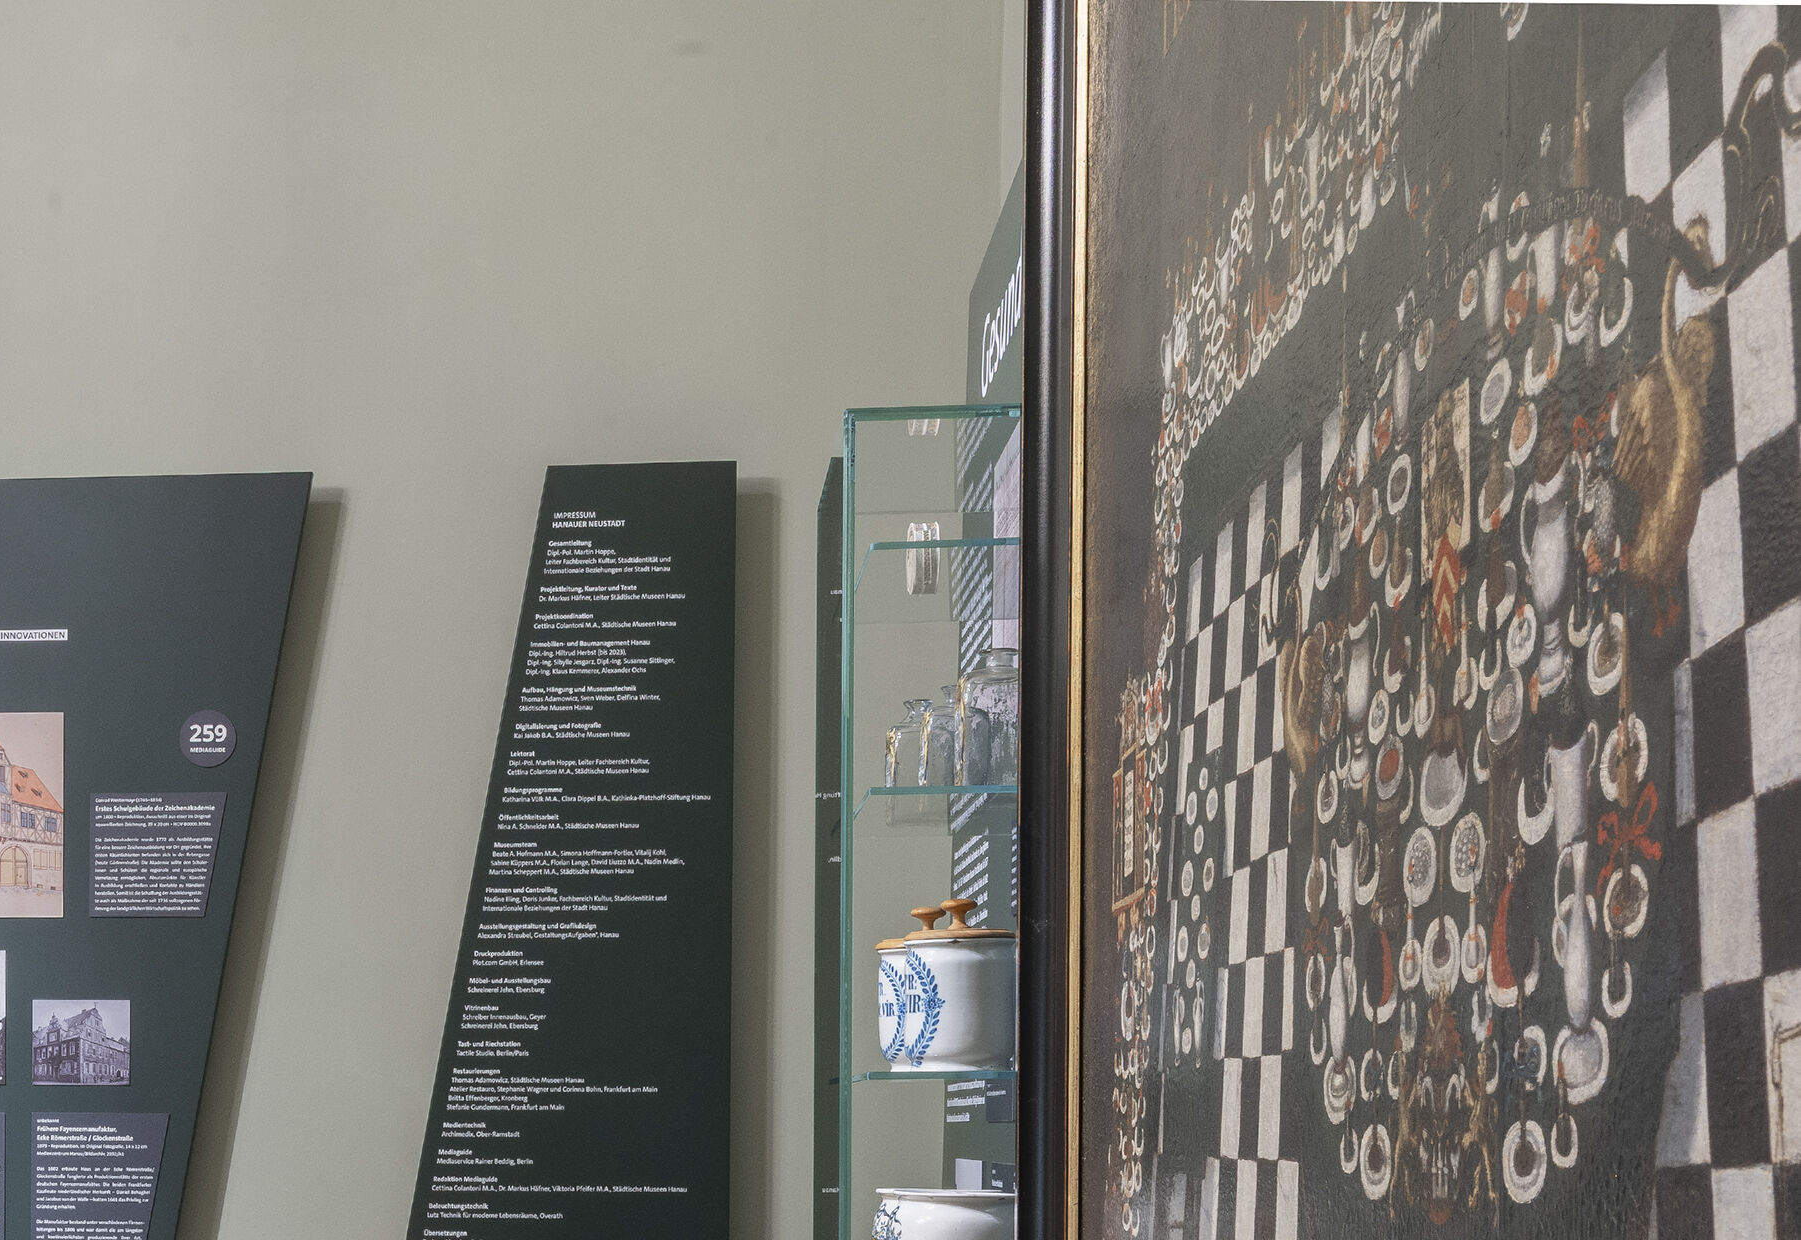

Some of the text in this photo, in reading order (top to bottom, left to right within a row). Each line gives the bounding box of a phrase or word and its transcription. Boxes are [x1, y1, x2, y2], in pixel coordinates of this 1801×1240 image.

[552, 520, 586, 528] HANAUER
[548, 539, 591, 547] Gesamtleitung
[547, 549, 572, 557] Dipl.-Pol.
[540, 585, 583, 593] Projektleitung,
[535, 612, 593, 621] Projektkoordination
[0, 631, 66, 640] INNOVATIONEN
[189, 724, 227, 743] 259
[438, 1148, 472, 1156] Mediaguide
[428, 1202, 488, 1211] Beleuchtungstechnik
[423, 1229, 467, 1237] Übersetzungen
